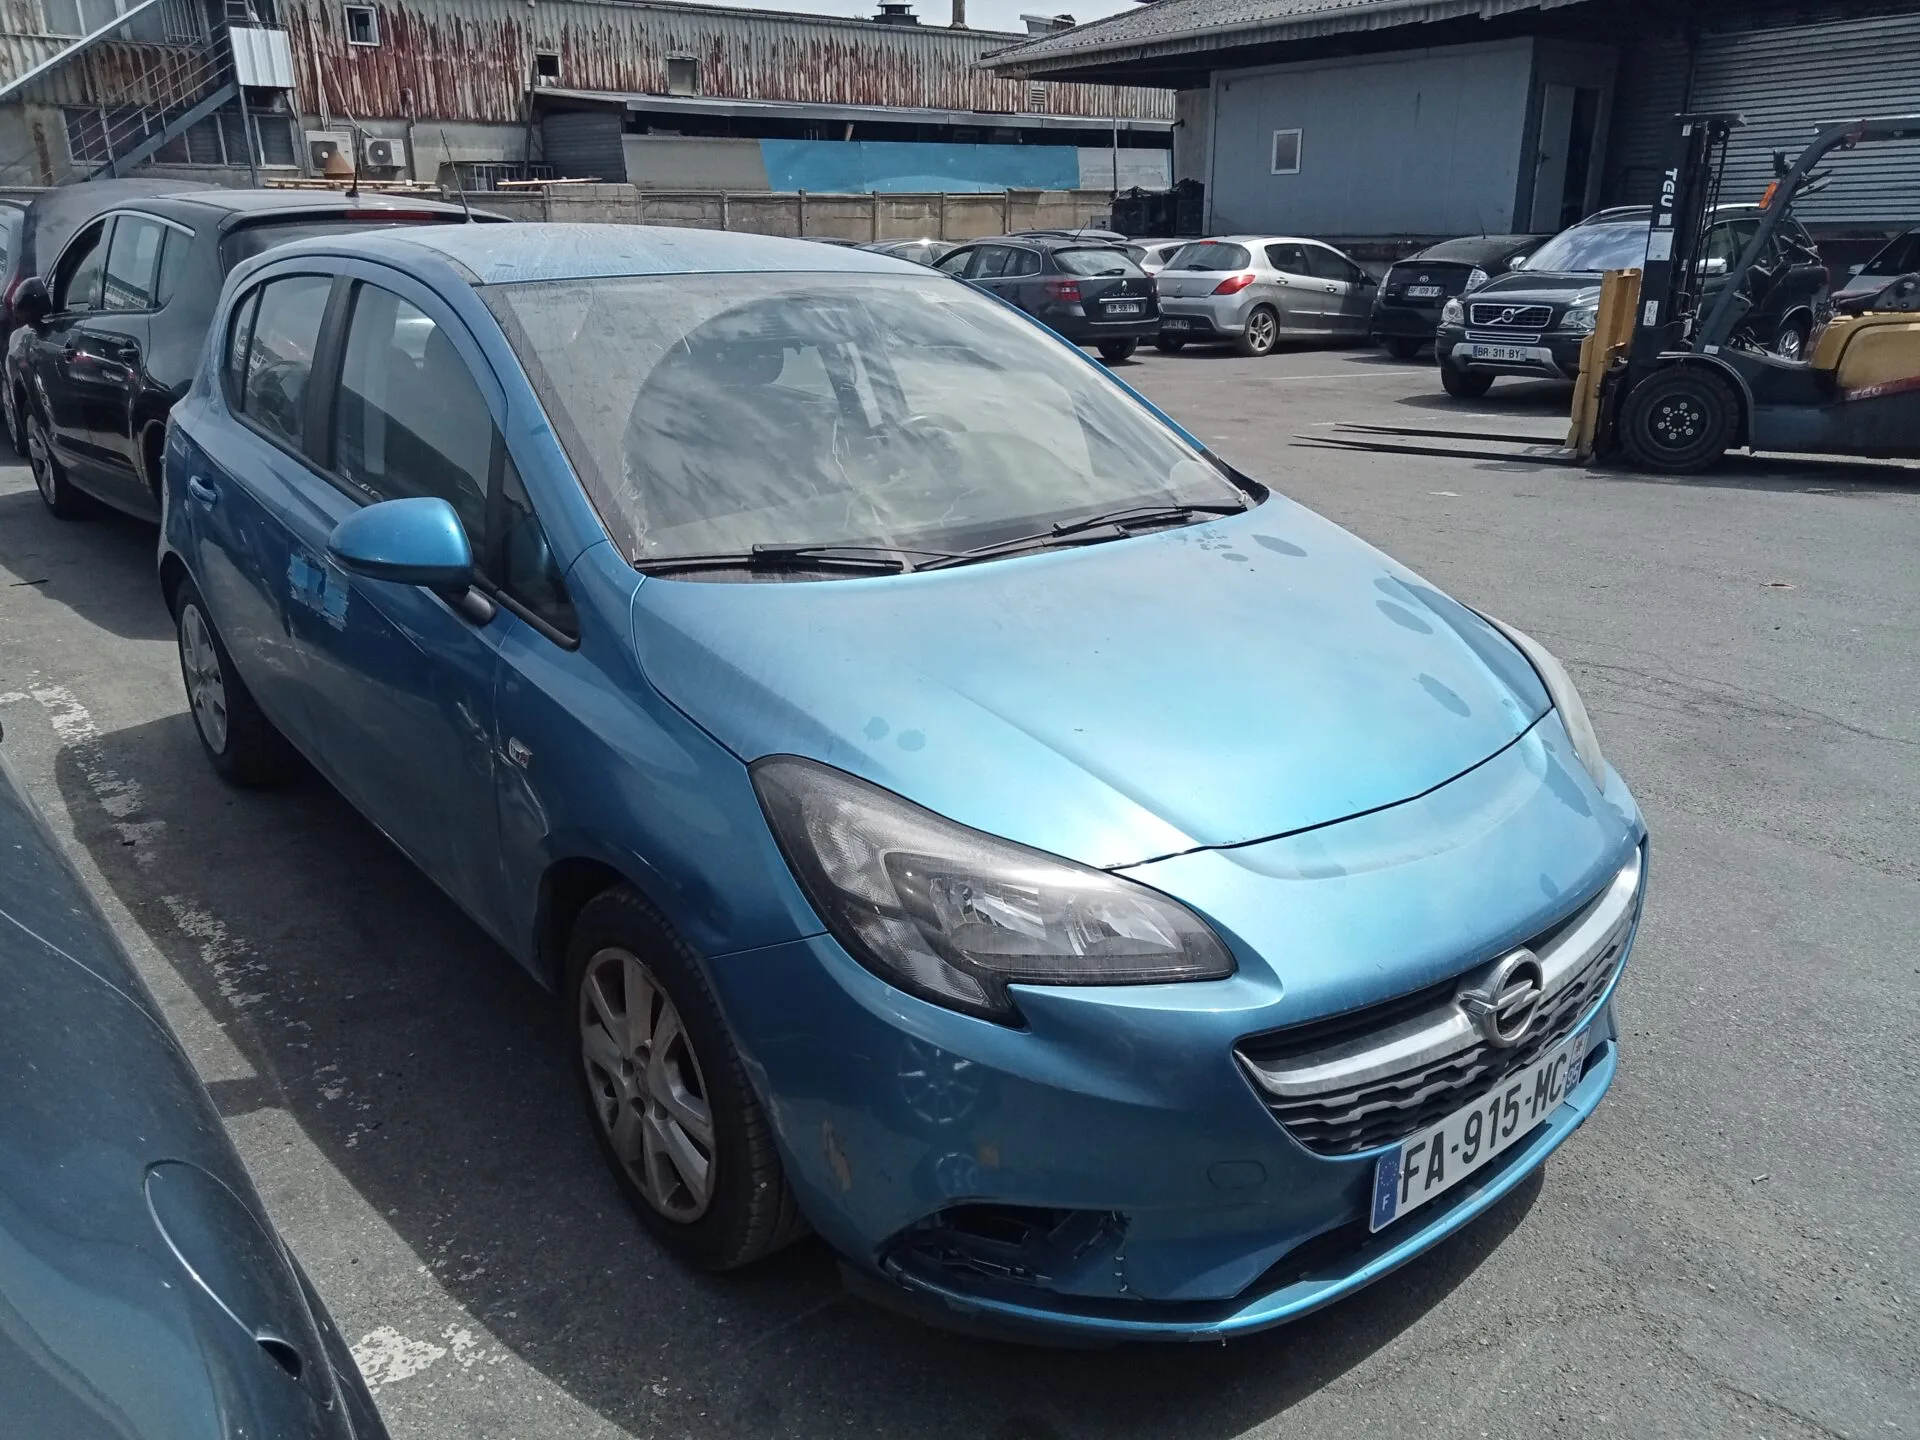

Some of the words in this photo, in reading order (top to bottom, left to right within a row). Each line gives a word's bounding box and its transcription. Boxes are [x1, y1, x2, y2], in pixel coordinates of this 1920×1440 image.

[1660, 168, 1678, 208] TEU
[1401, 1052, 1567, 1205] FA-915-MC
[1382, 1193, 1390, 1211] F
